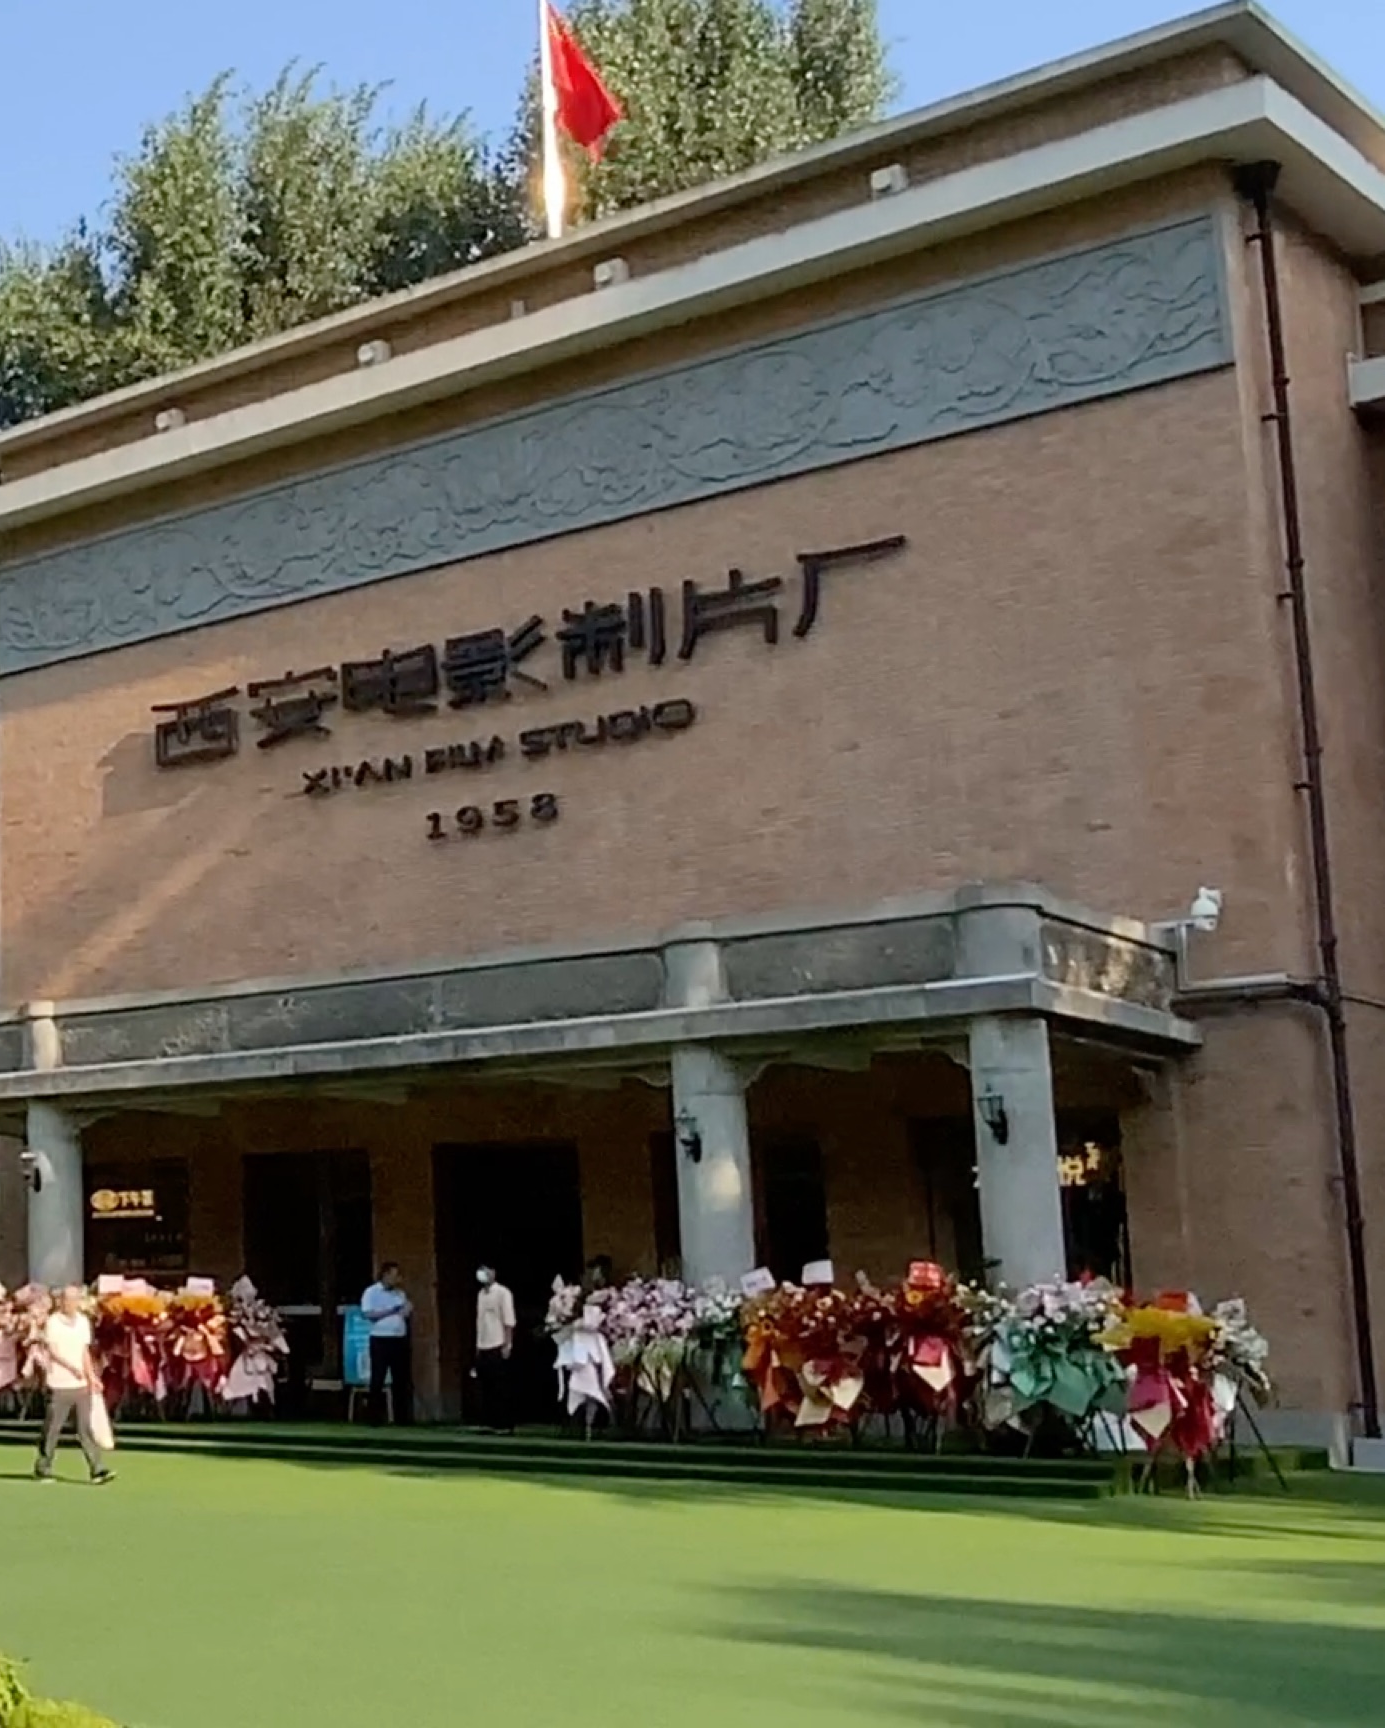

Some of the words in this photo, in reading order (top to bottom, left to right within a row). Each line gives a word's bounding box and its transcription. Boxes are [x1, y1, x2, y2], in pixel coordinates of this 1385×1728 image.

[150, 533, 908, 768] 西安电影制片厂
[302, 754, 414, 795] XI'AN
[518, 698, 697, 758] STUDIO
[425, 793, 560, 840] 1958
